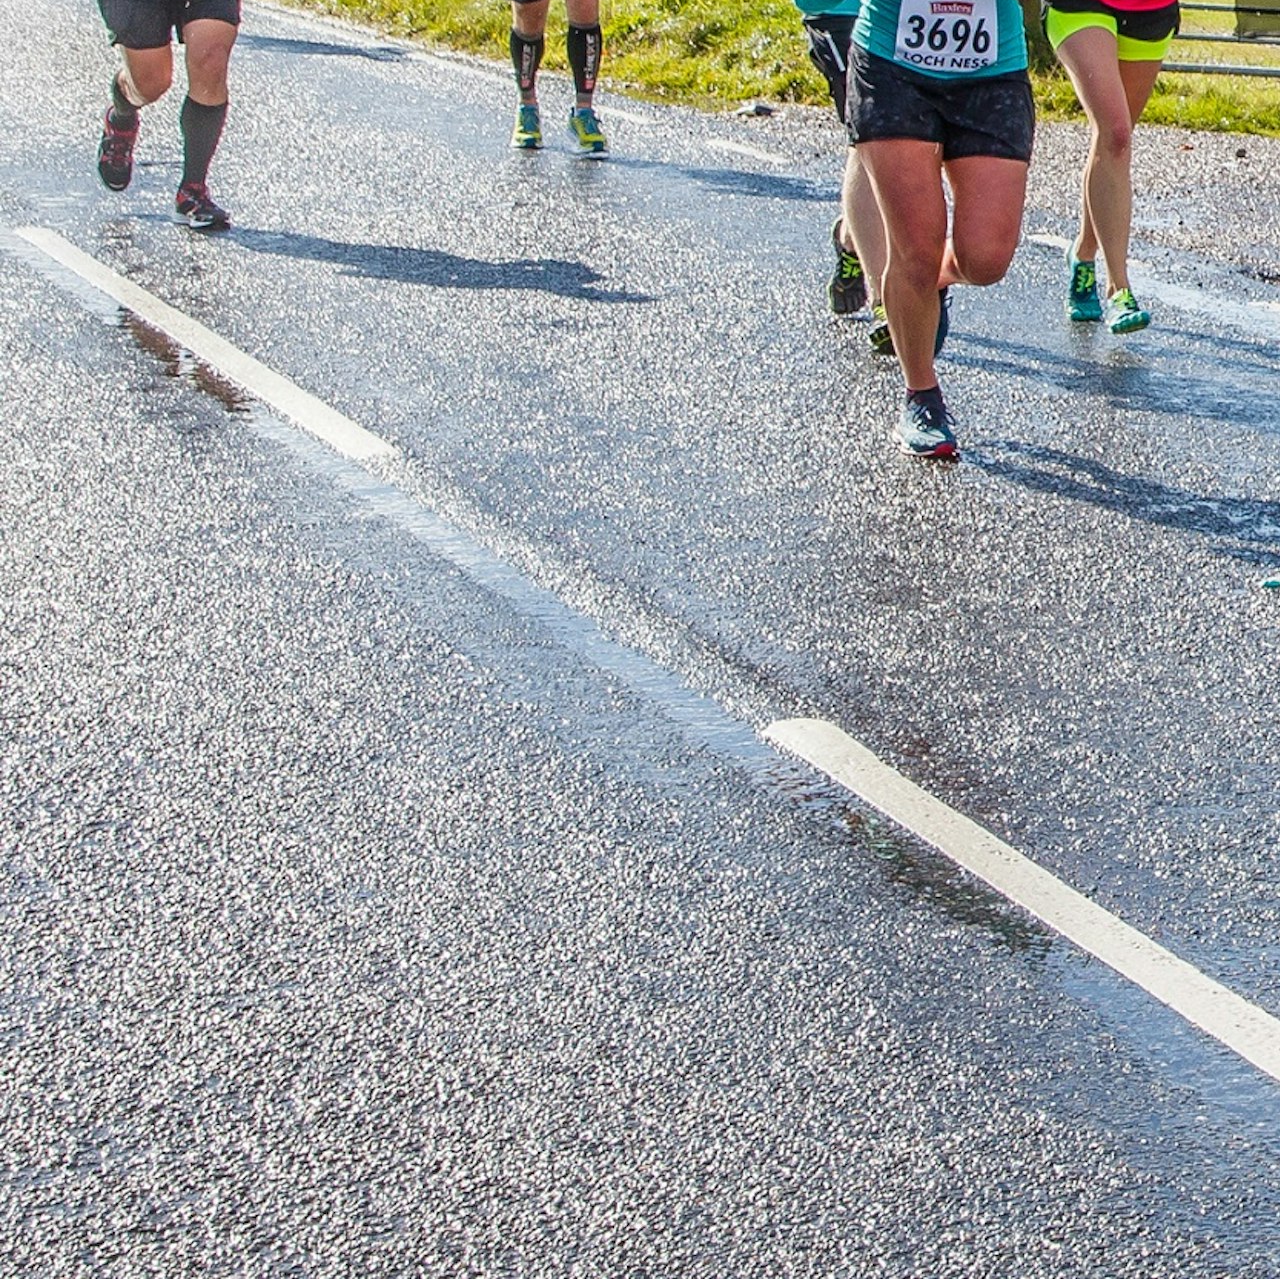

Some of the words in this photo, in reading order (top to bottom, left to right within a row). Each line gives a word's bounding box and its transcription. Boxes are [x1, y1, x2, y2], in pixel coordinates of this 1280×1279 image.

[932, 2, 972, 14] Baxters
[904, 15, 990, 54] 3696
[903, 52, 945, 67] LOCH
[950, 58, 990, 69] NESS
